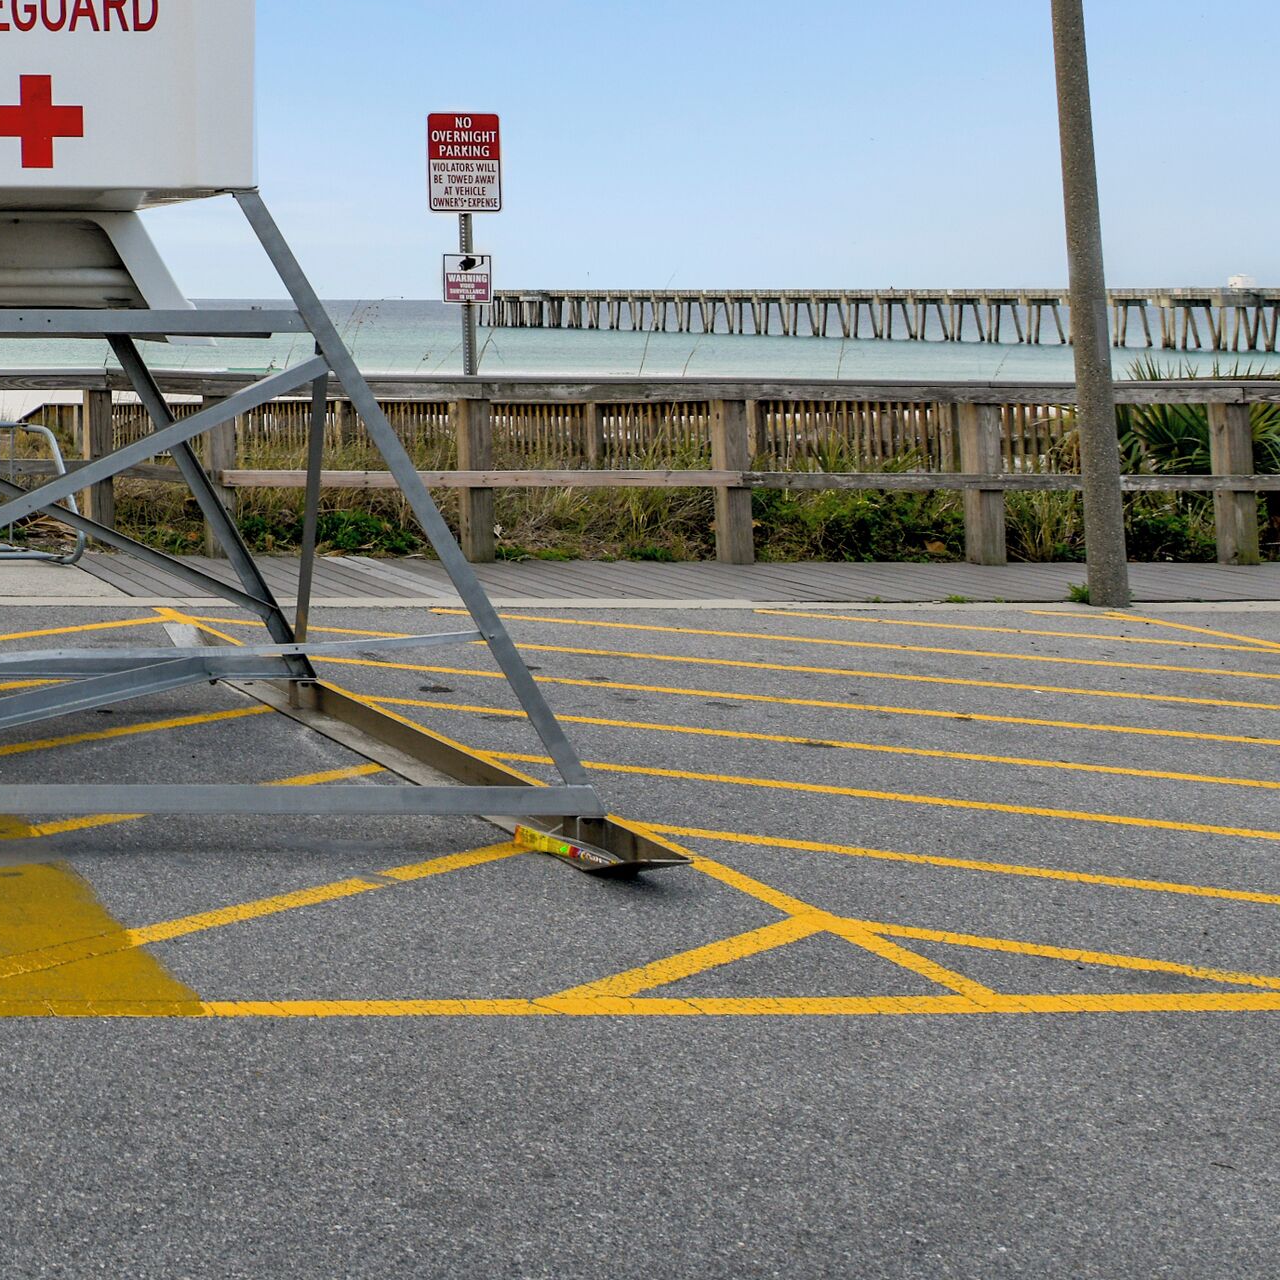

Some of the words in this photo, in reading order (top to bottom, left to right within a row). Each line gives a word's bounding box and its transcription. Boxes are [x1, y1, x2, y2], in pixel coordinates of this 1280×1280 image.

[454, 116, 472, 128] NO
[431, 130, 497, 143] OVERNIGHT
[439, 144, 490, 157] PARKING
[432, 162, 474, 173] VIOLATORS
[476, 163, 496, 173] WILL
[433, 174, 443, 184] BE
[447, 174, 473, 184] TOWED
[475, 175, 496, 184] AWAY
[444, 186, 452, 195] AT
[455, 186, 486, 196] VEHICLE
[433, 197, 464, 207] OWNER'S
[468, 197, 498, 207] EXPENSE
[447, 274, 487, 283] WARNING
